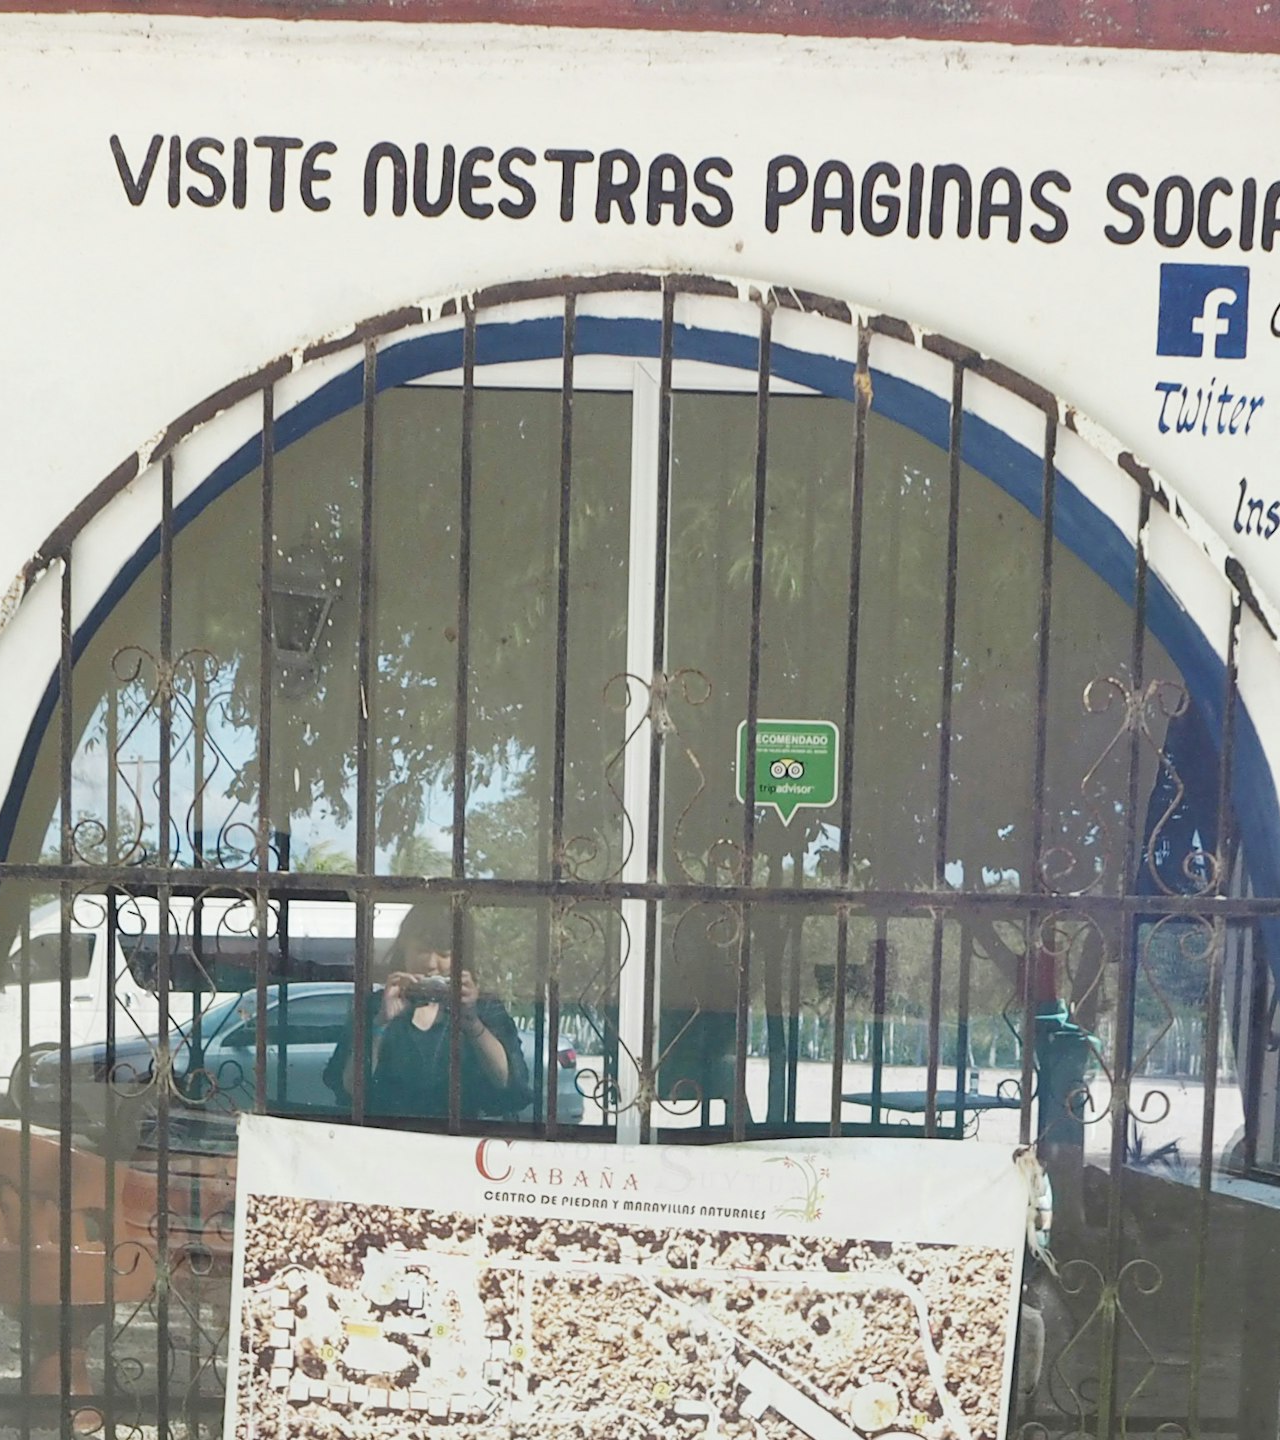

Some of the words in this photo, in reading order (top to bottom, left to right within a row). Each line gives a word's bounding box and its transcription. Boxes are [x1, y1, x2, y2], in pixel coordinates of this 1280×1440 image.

[109, 134, 338, 213] VISITE
[363, 141, 734, 229] NUESTRAS
[764, 154, 1072, 245] PAGINAS
[1154, 376, 1265, 437] Twiter
[756, 735, 828, 745] ECOMENDADO
[475, 1138, 639, 1191] CABAÑA
[483, 1190, 536, 1205] CENTRO
[540, 1194, 559, 1207] DE
[562, 1196, 608, 1210] PIEDRA
[612, 1199, 620, 1210] Y
[622, 1200, 696, 1216] MARAVILLAS
[699, 1206, 766, 1221] NATURALES
